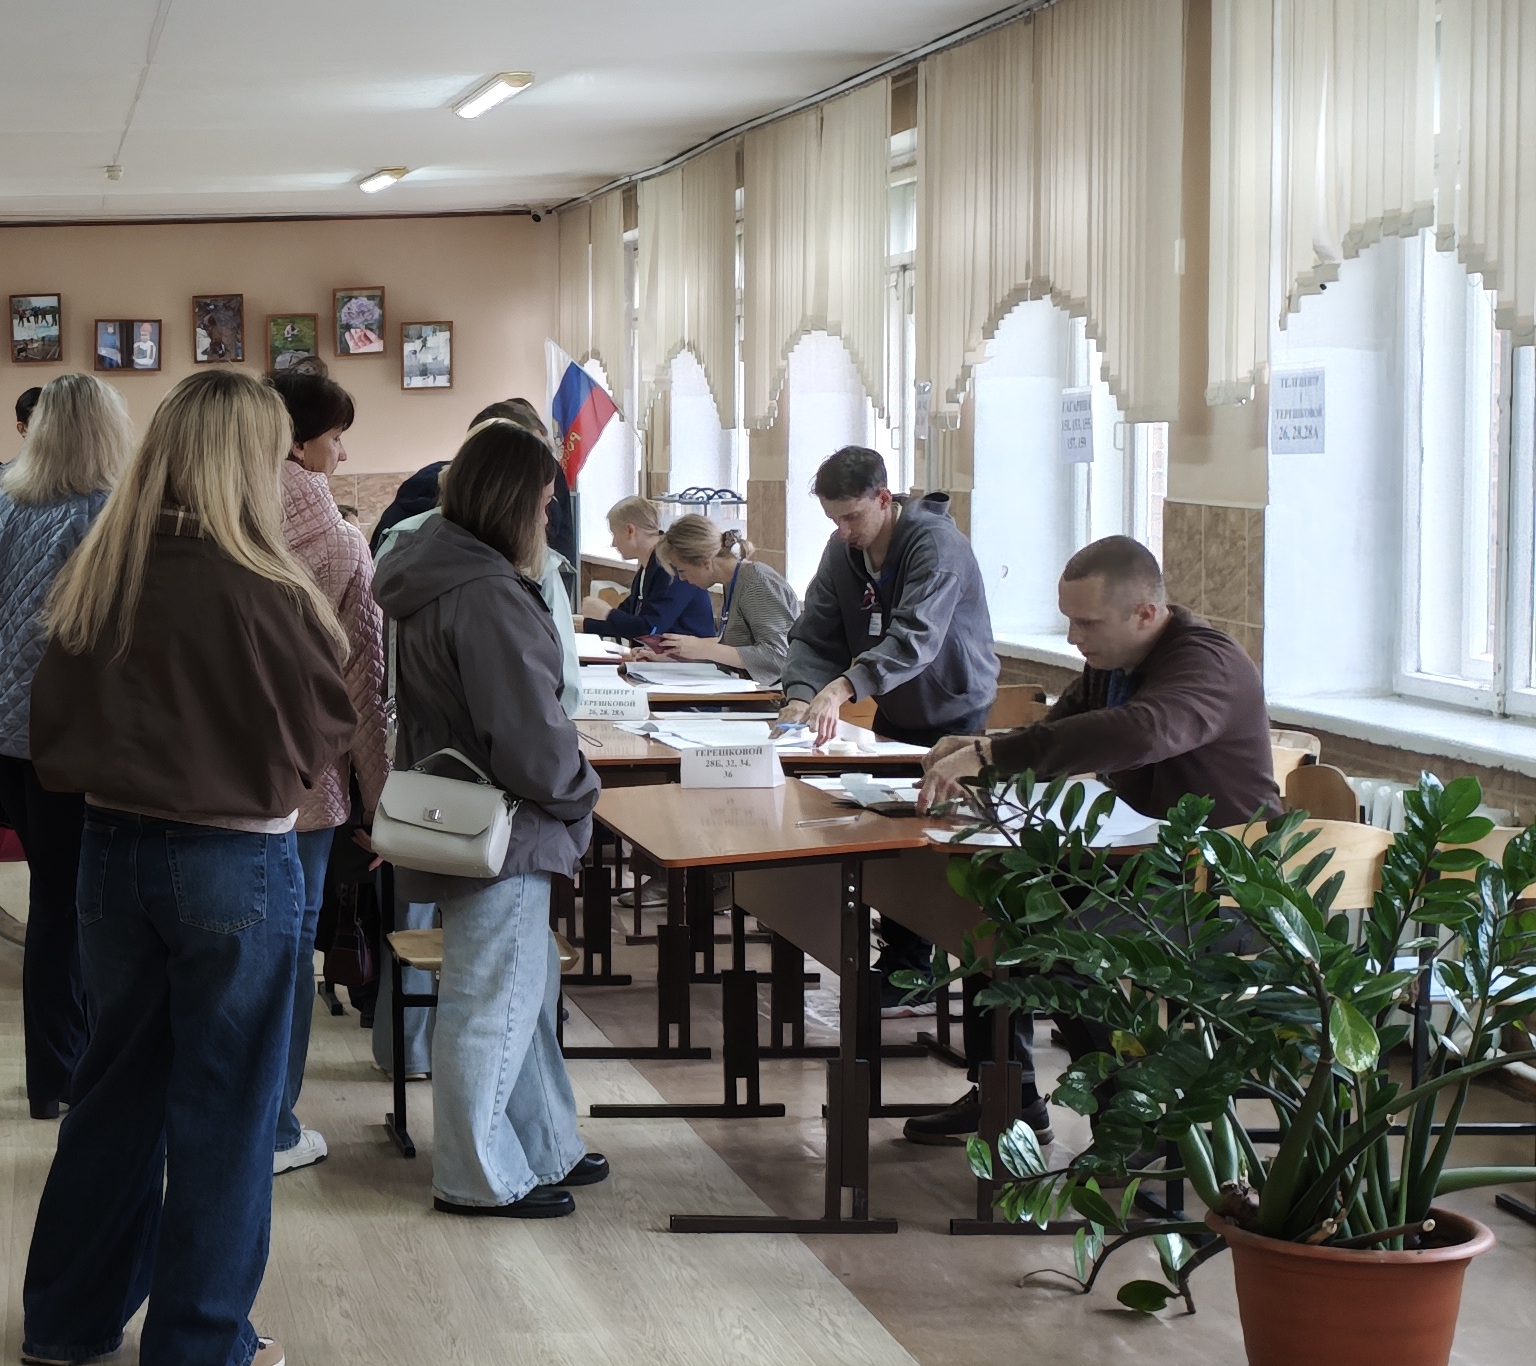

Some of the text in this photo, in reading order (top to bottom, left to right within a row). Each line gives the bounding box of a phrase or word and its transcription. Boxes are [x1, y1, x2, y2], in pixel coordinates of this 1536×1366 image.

[695, 747, 763, 757] ТЕРЕШКОВОЙ
[725, 759, 738, 768] 32,
[723, 770, 733, 778] 36
